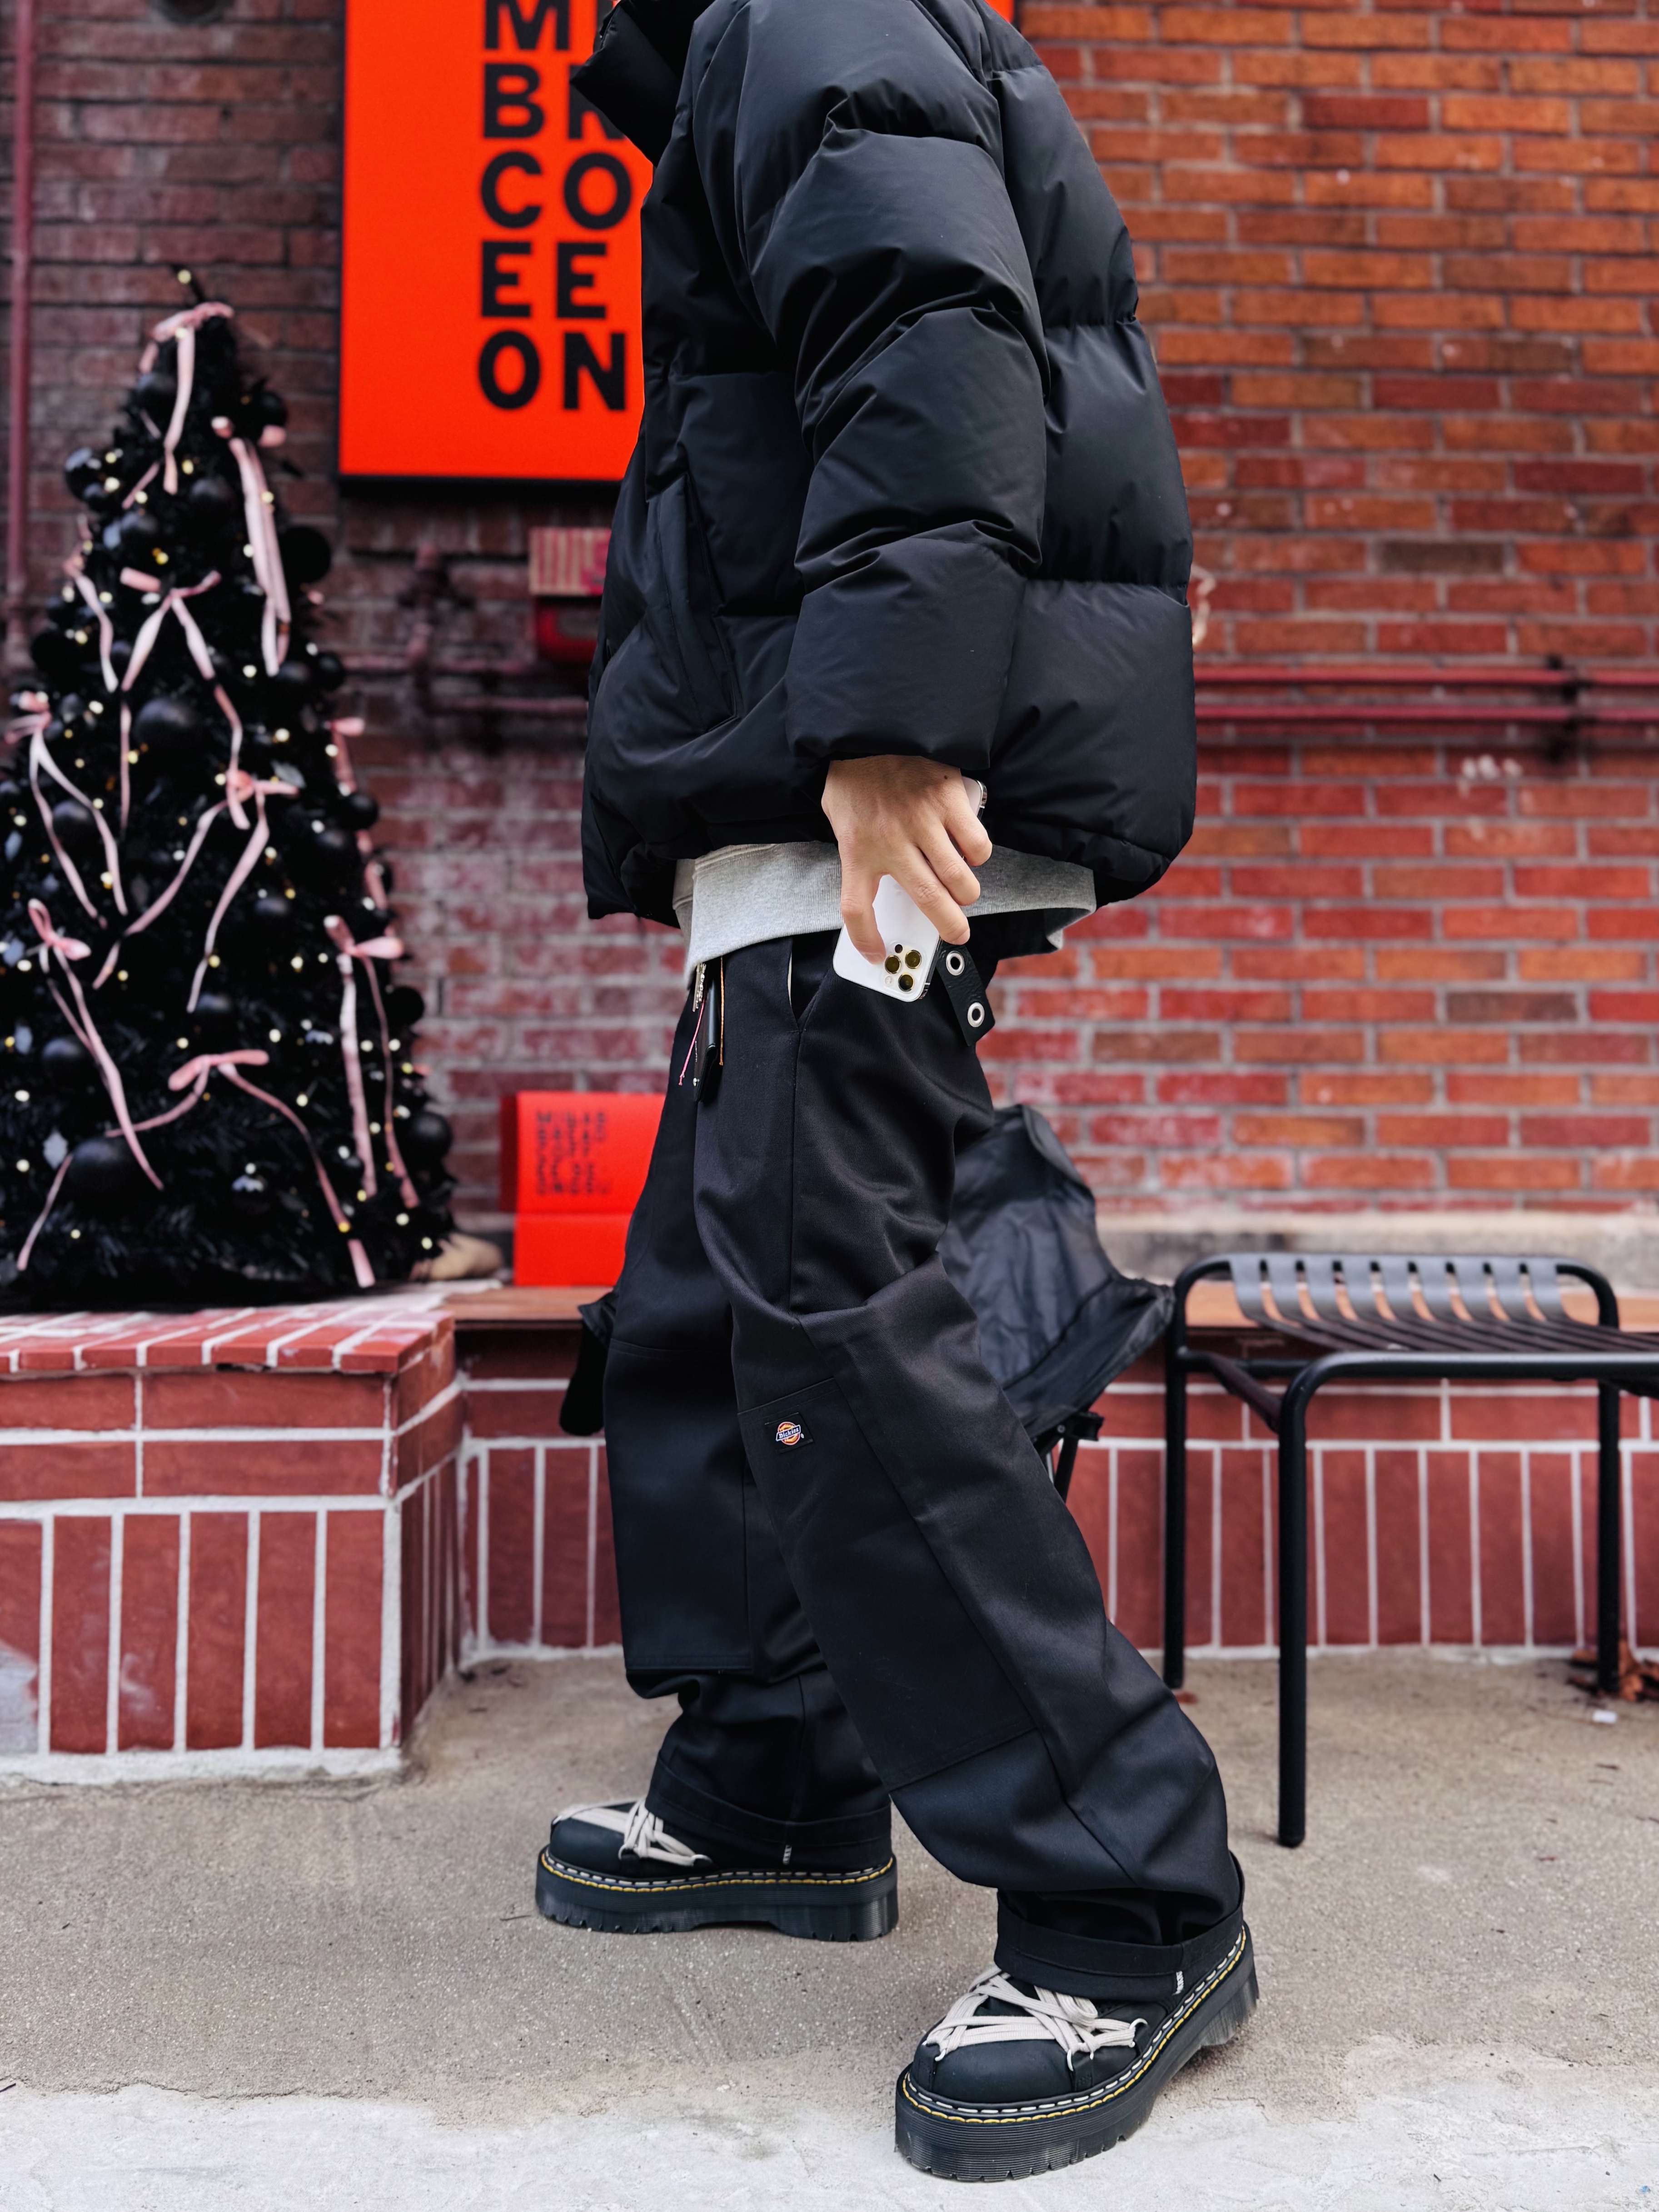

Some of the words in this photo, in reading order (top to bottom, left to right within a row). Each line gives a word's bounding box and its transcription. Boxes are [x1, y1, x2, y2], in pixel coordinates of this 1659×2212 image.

[480, 151, 632, 230] CO
[480, 241, 607, 319] EE
[478, 330, 627, 411] ON
[778, 1428, 799, 1439] Dickies
